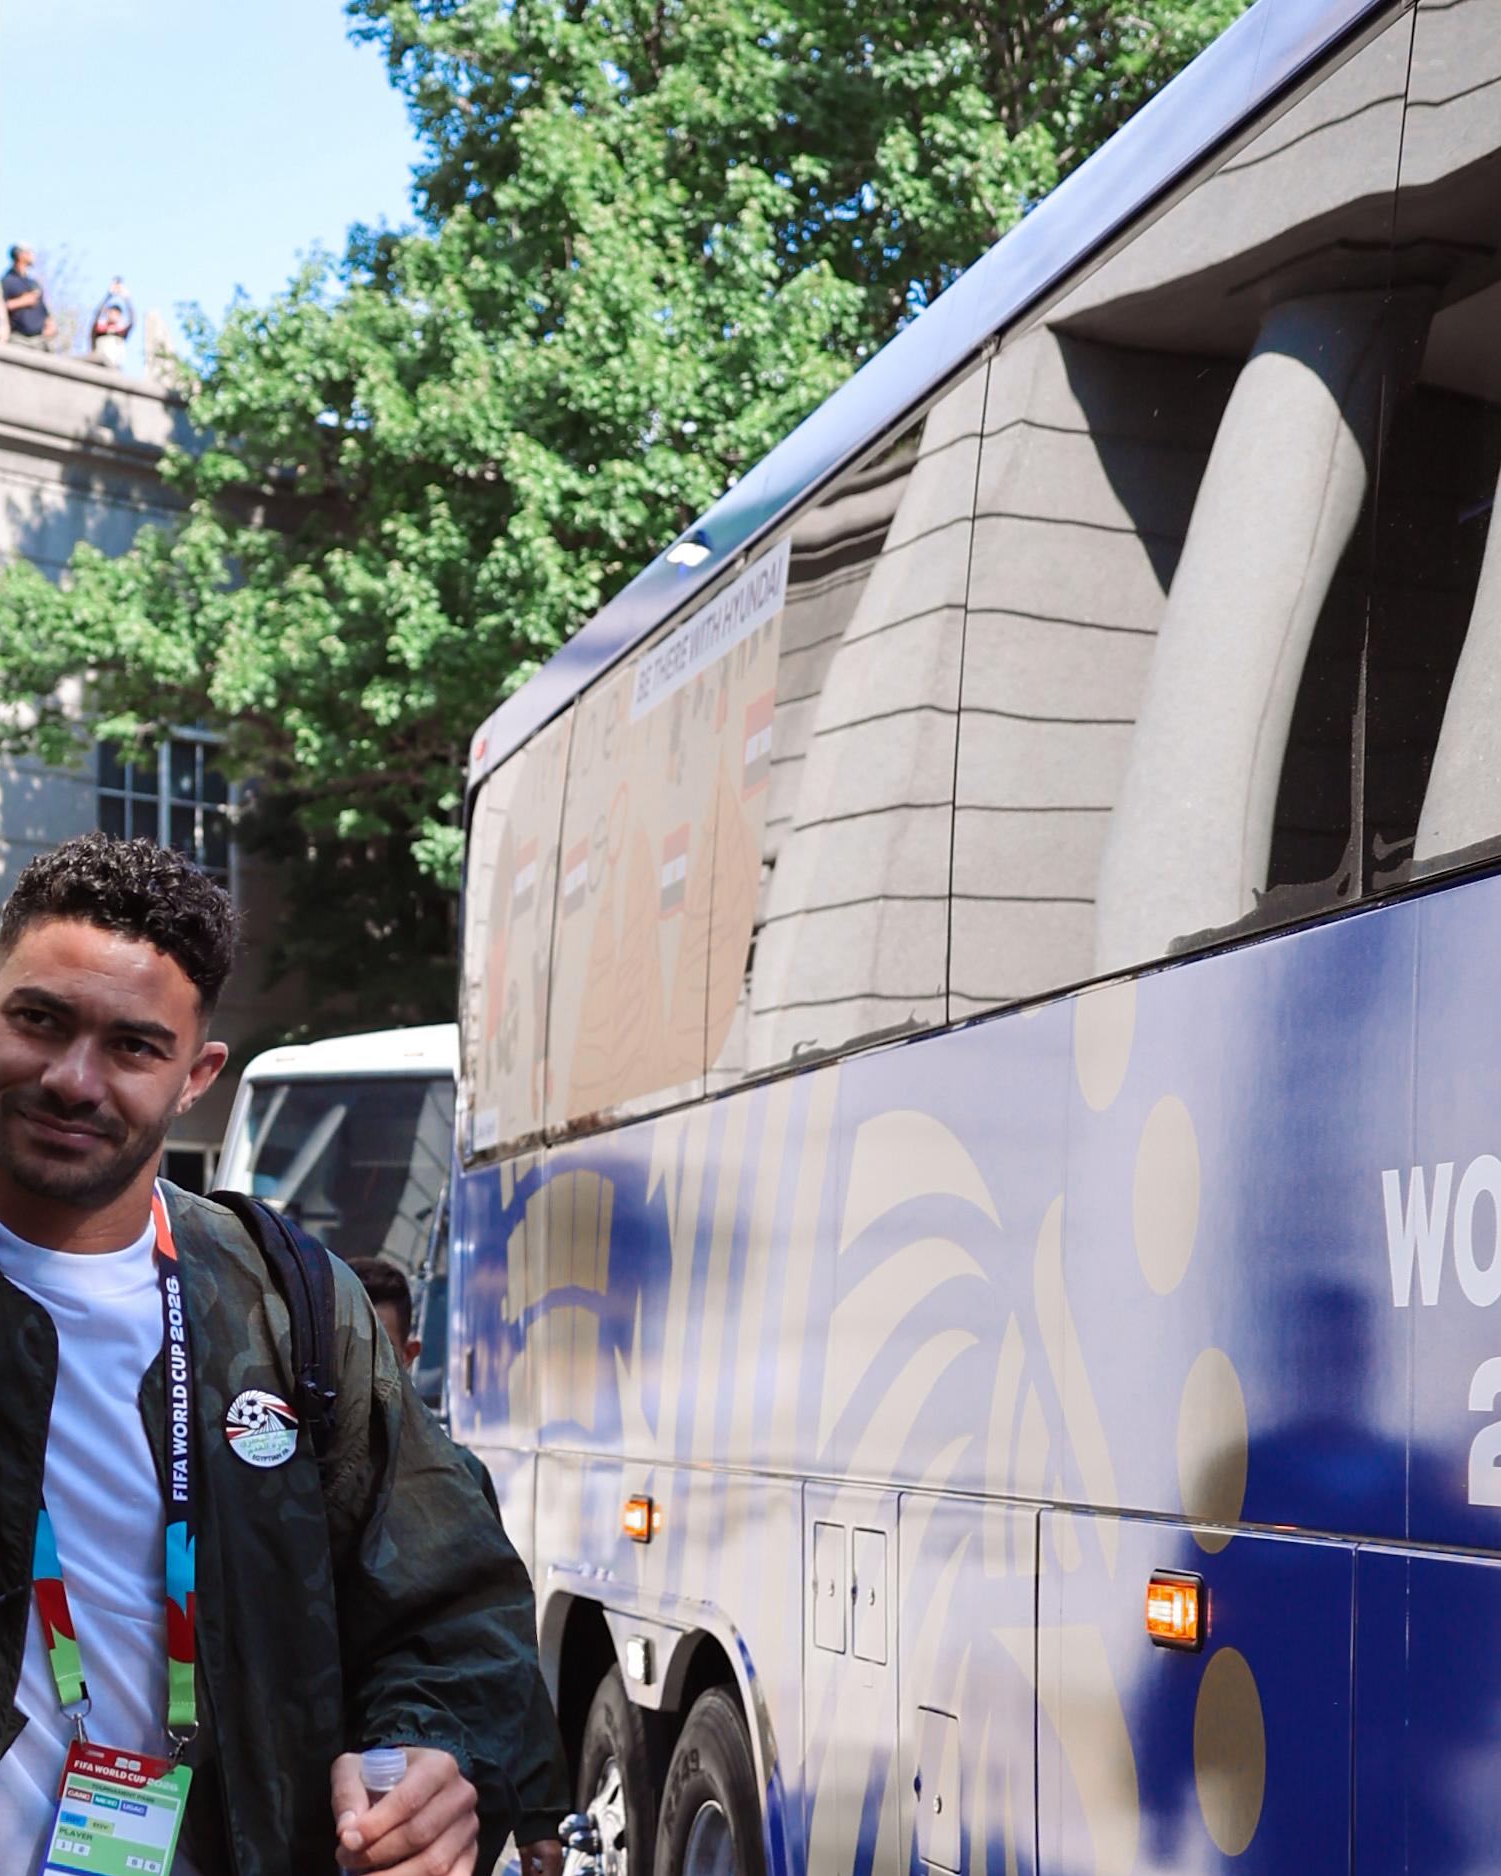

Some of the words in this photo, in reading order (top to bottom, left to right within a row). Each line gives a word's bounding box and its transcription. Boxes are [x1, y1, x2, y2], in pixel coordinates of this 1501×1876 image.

[689, 606, 723, 664] WITH
[721, 556, 783, 638] HYUNDAI
[166, 1275, 185, 1343] 2026
[172, 1349, 188, 1382] CUP
[172, 1386, 188, 1457] WORLD
[172, 1460, 188, 1502] FIFA
[74, 1760, 93, 1771] FIFA
[95, 1764, 127, 1780] WORLD
[128, 1773, 146, 1783] CUP
[59, 1827, 93, 1841] PLAYER
